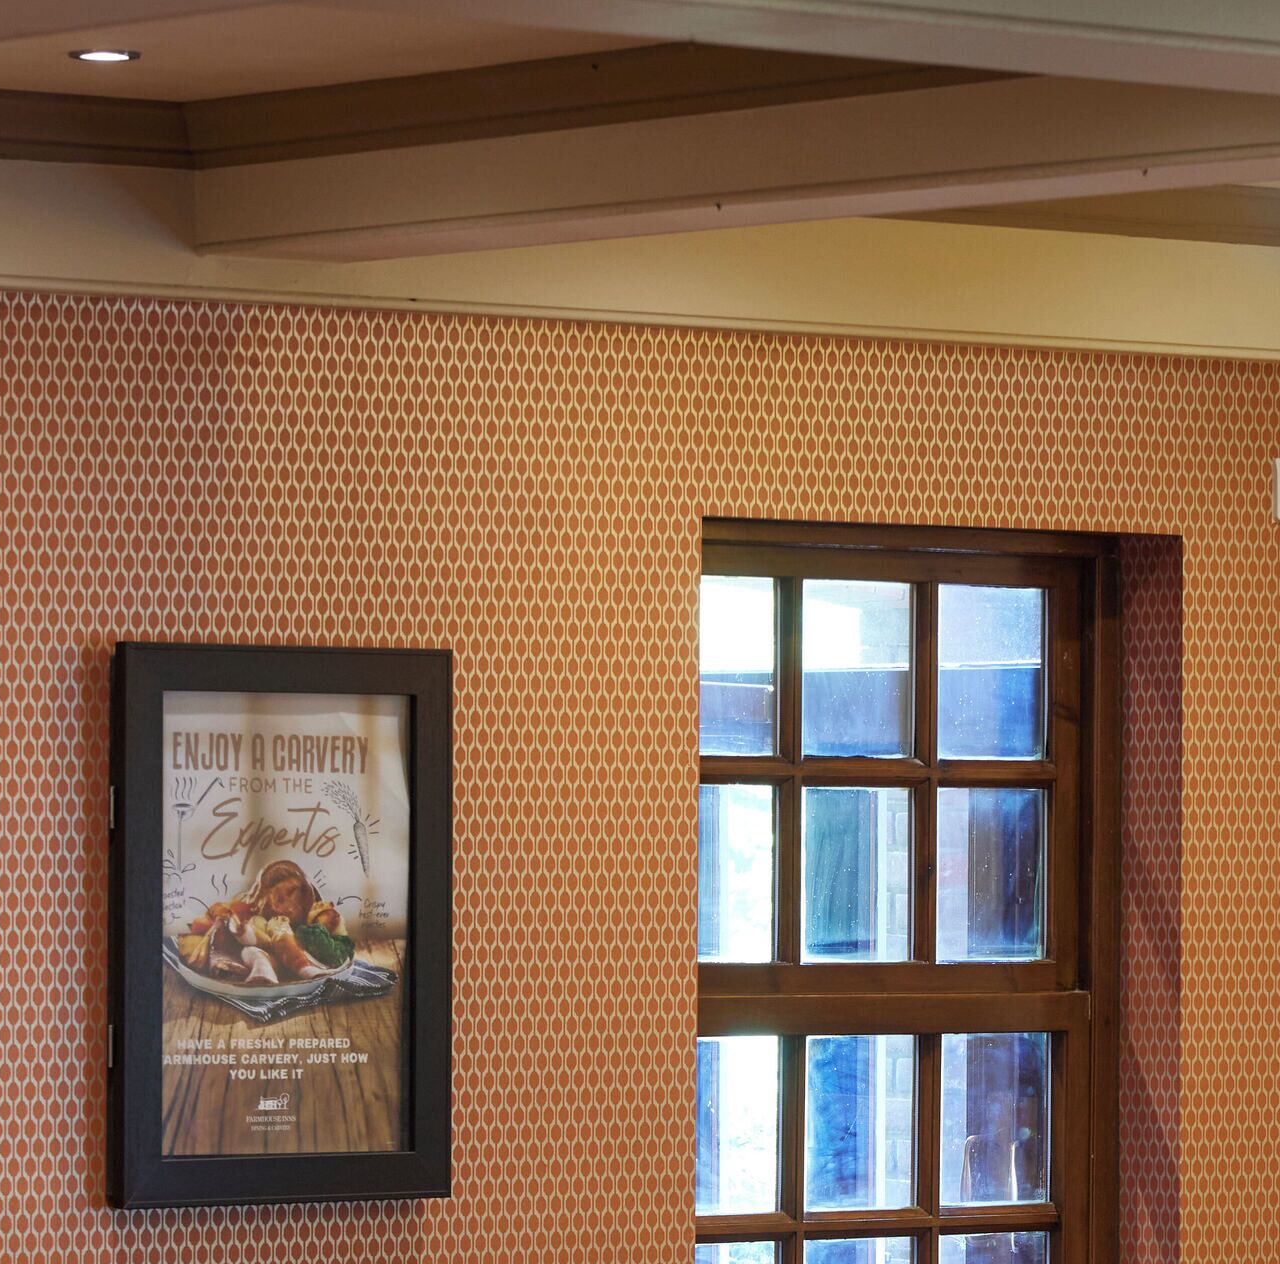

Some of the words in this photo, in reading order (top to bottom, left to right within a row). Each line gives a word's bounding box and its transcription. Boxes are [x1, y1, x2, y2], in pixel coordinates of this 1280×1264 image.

[172, 732, 243, 771] ENJOY
[251, 734, 265, 771] A
[272, 734, 369, 774] CARVERY
[229, 777, 276, 793] FROM
[283, 778, 313, 794] THE
[201, 797, 340, 876] Experts
[177, 1039, 212, 1050] HAVE
[217, 1039, 226, 1049] A
[230, 1039, 284, 1050] FRESHLY
[289, 1038, 351, 1049] PREPARED
[163, 1054, 236, 1065] ARMHOUSE
[241, 1054, 303, 1065] CARVERY,
[306, 1053, 337, 1064] JUST
[341, 1053, 369, 1064] HOW
[229, 1069, 256, 1080] YOU
[260, 1069, 288, 1080] LIKE
[292, 1069, 304, 1080] IT
